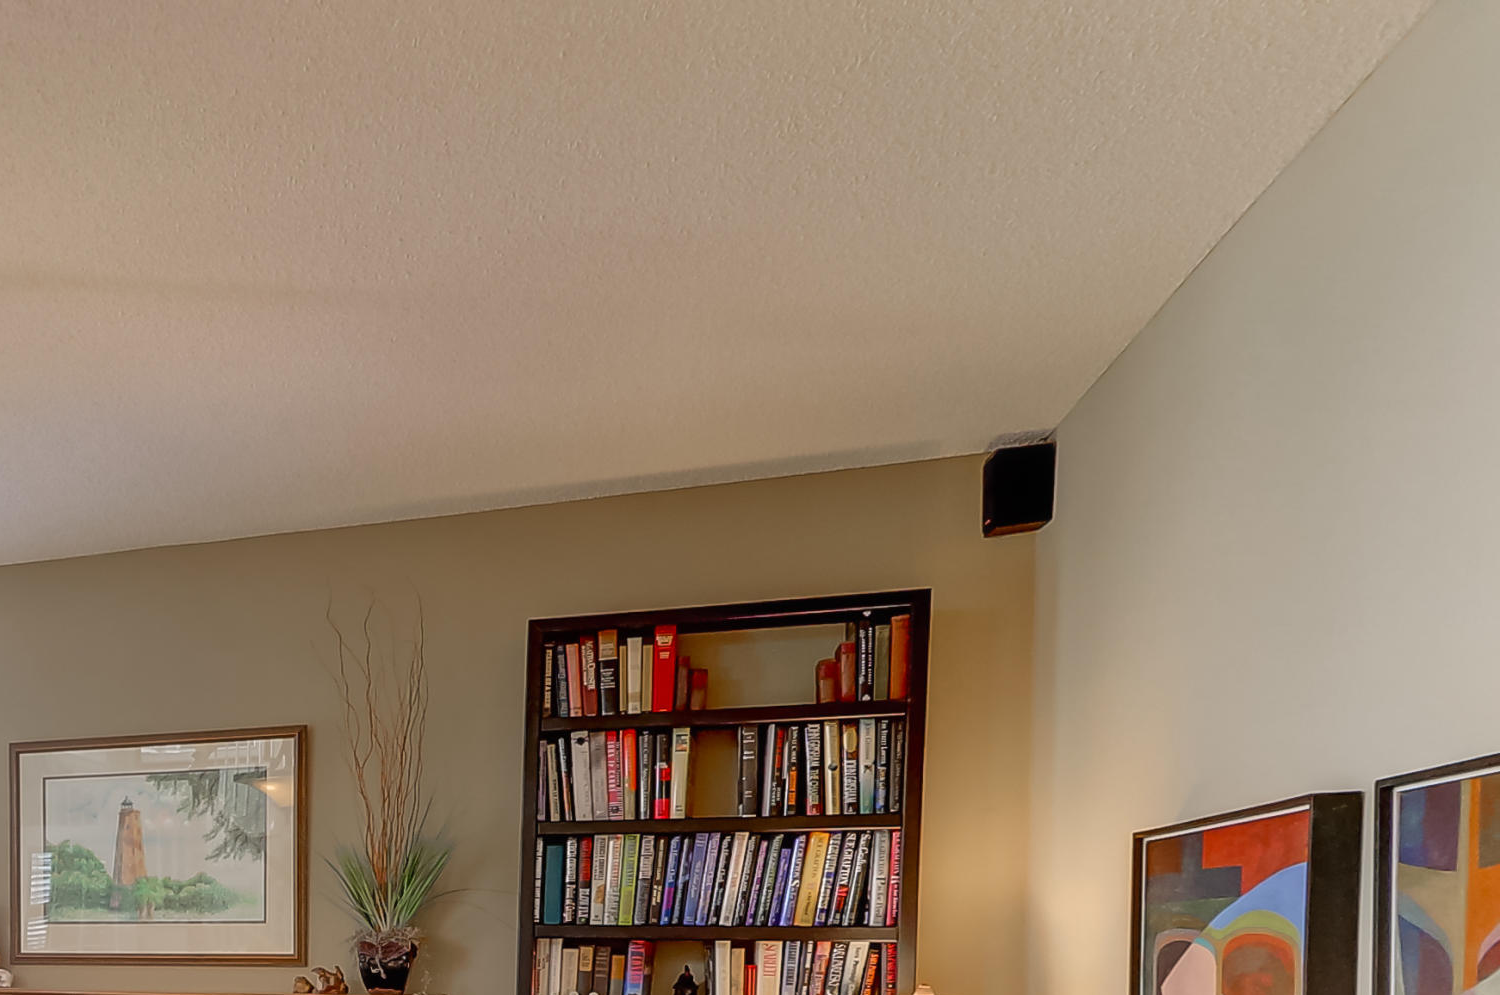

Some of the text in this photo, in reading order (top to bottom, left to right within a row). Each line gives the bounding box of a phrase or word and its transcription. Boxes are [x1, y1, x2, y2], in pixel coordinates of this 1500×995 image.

[808, 724, 821, 739] JOHN
[808, 739, 821, 767] GRISHAM
[809, 769, 819, 780] THE
[845, 833, 857, 848] SUE
[859, 833, 872, 846] Sue
[839, 848, 855, 886] GRAFTON
[879, 846, 887, 876] GRAFTON
[876, 877, 887, 885] P
